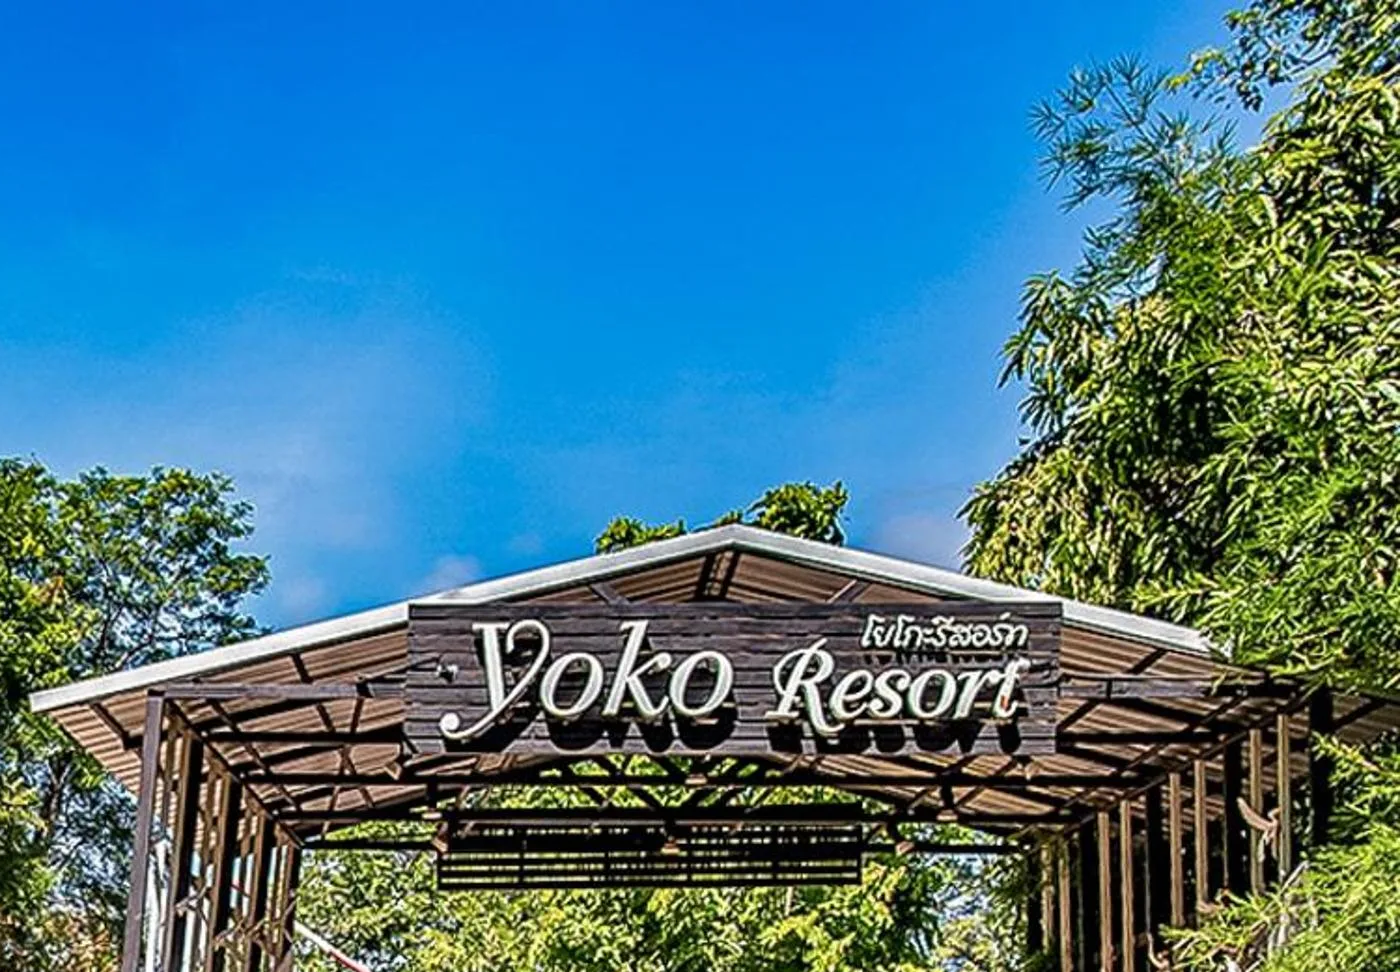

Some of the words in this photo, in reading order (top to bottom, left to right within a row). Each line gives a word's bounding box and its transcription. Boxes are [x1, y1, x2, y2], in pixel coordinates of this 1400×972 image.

[860, 611, 1029, 648] โยโกะรีสอร์ท
[439, 619, 734, 740] Yoko
[764, 637, 1032, 733] Resort
